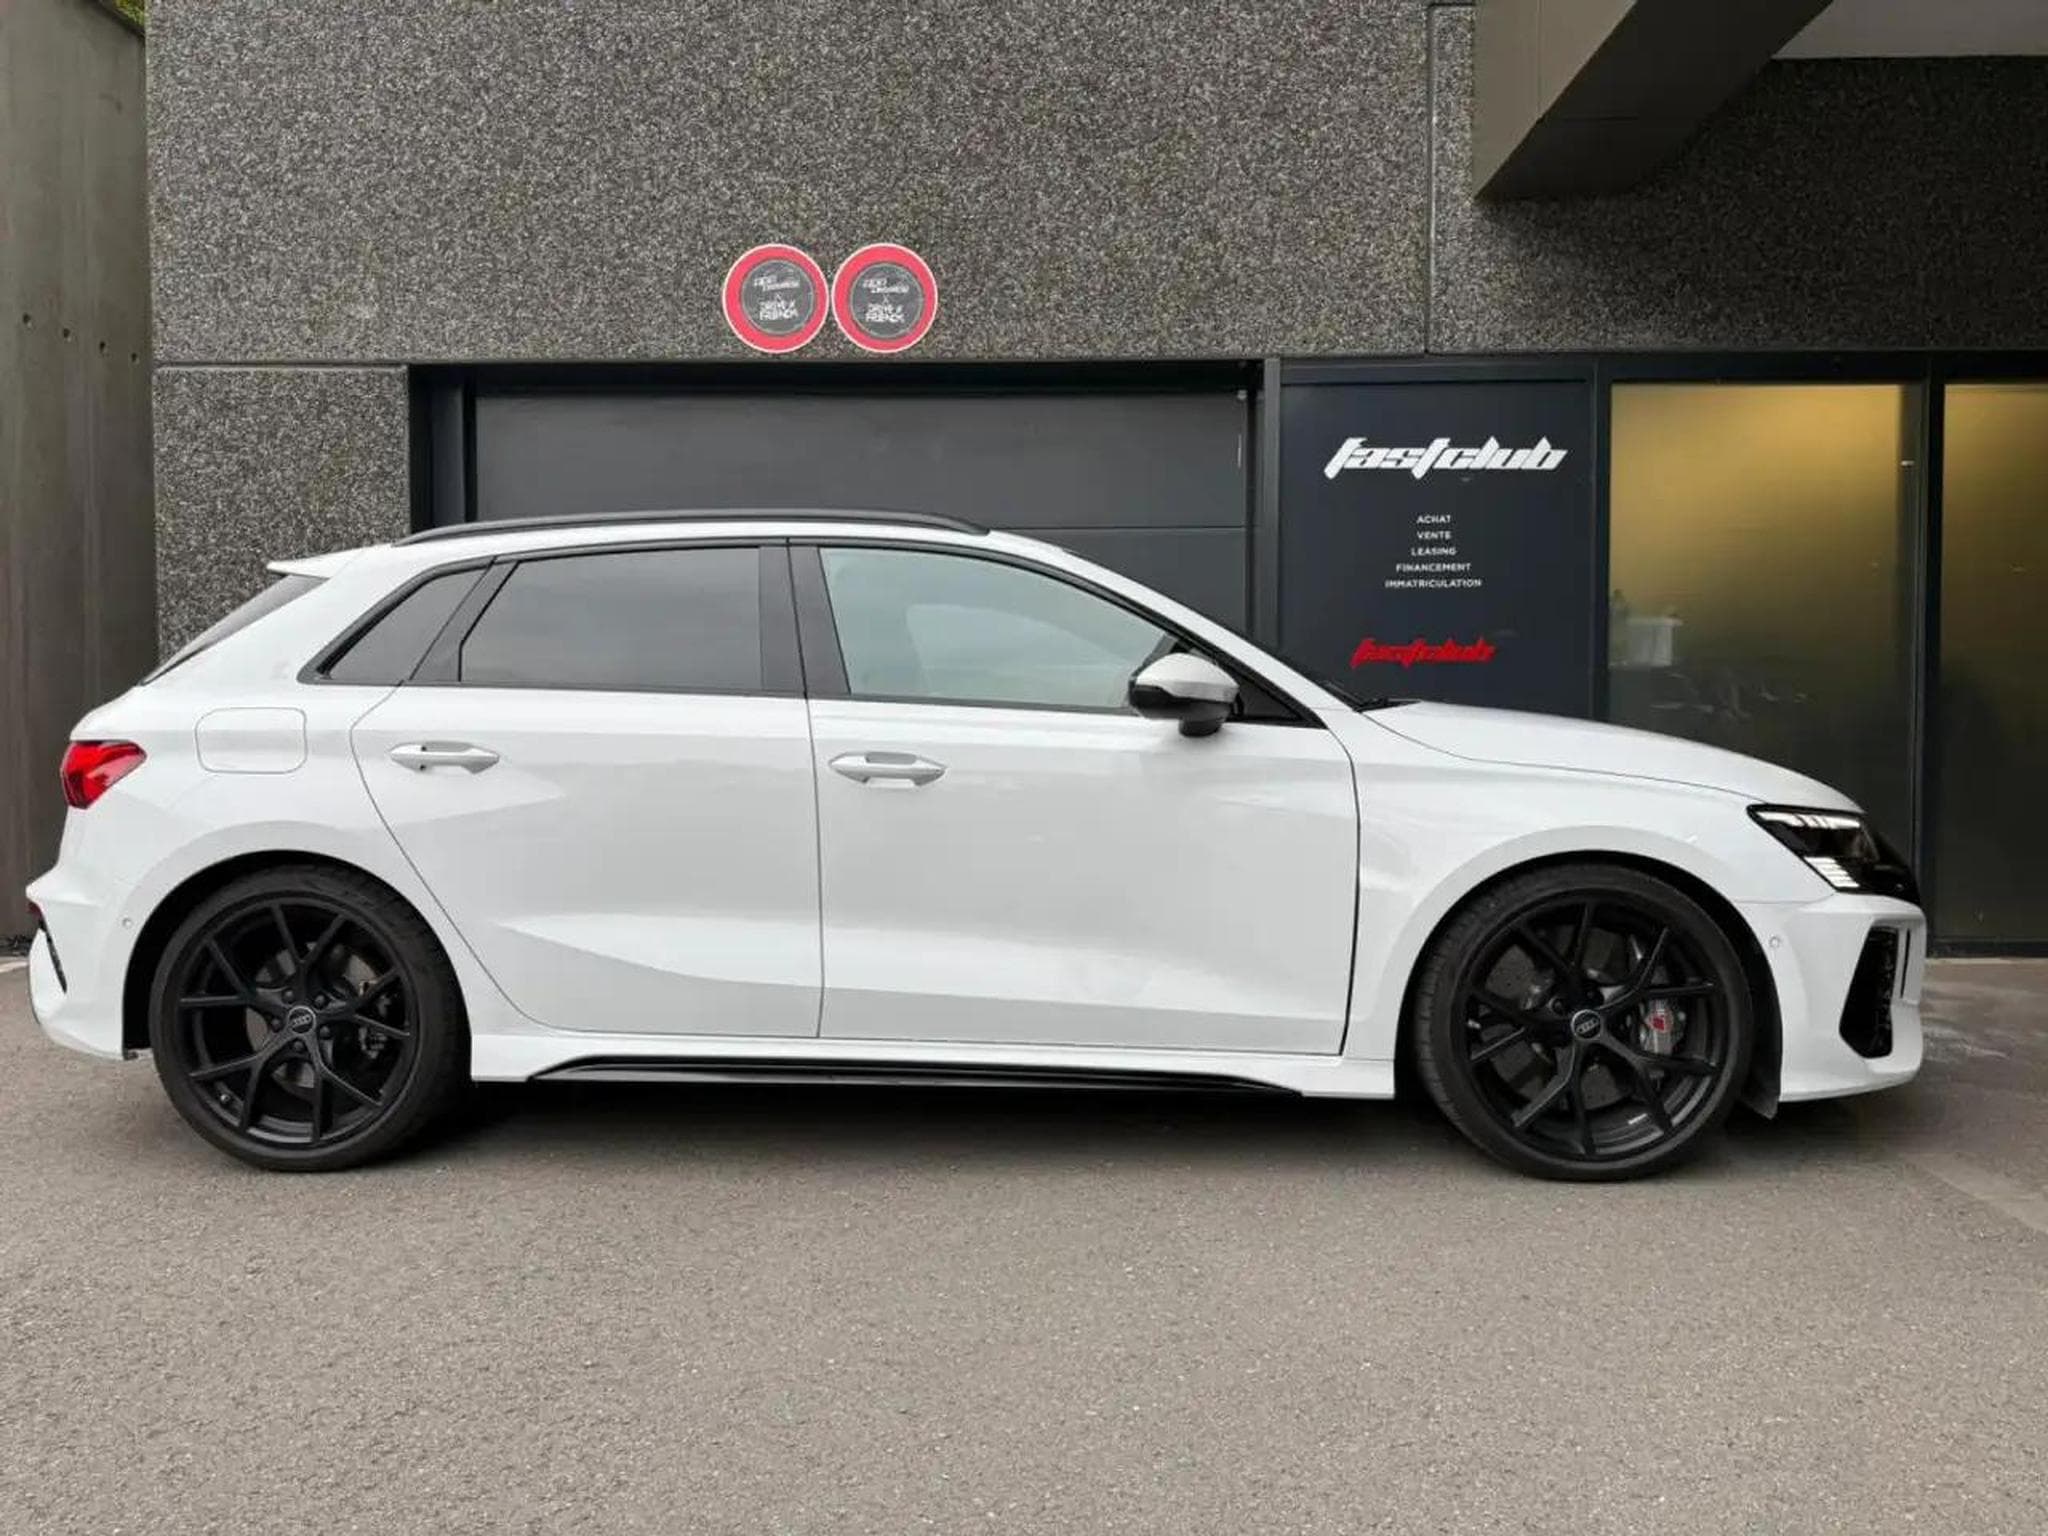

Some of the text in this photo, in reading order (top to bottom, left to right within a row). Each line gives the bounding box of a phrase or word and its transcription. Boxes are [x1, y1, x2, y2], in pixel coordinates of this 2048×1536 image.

[1323, 435, 1568, 480] fastclub
[1416, 514, 1451, 524] ACHAT
[1416, 530, 1451, 540] VENTE
[1410, 546, 1457, 556] LEASING
[1395, 562, 1471, 573] FINANCEMENT
[1384, 578, 1482, 589] IMMATRICULATION
